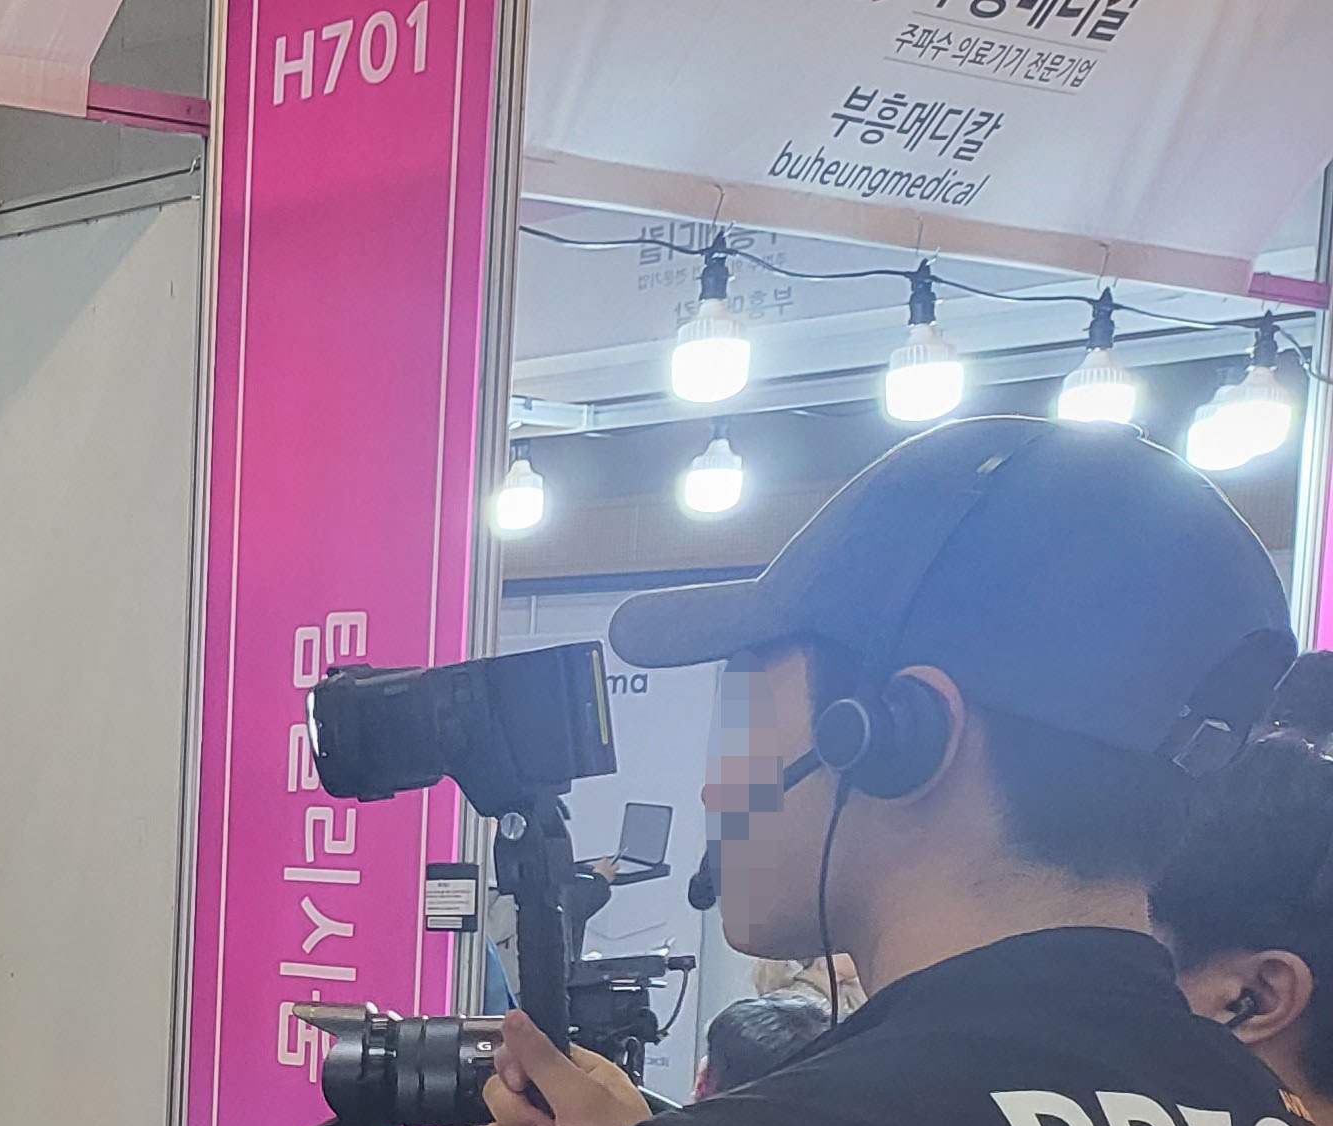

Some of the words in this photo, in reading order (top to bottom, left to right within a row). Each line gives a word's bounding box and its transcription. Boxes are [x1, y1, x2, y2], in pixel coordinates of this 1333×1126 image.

[273, 0, 428, 106] H701
[895, 24, 952, 60] 주파수
[952, 37, 1030, 76] 의료기기
[1024, 51, 1097, 88] 전문기업
[831, 86, 1004, 162] 부흥메디칼
[768, 140, 990, 207] buheungmedical
